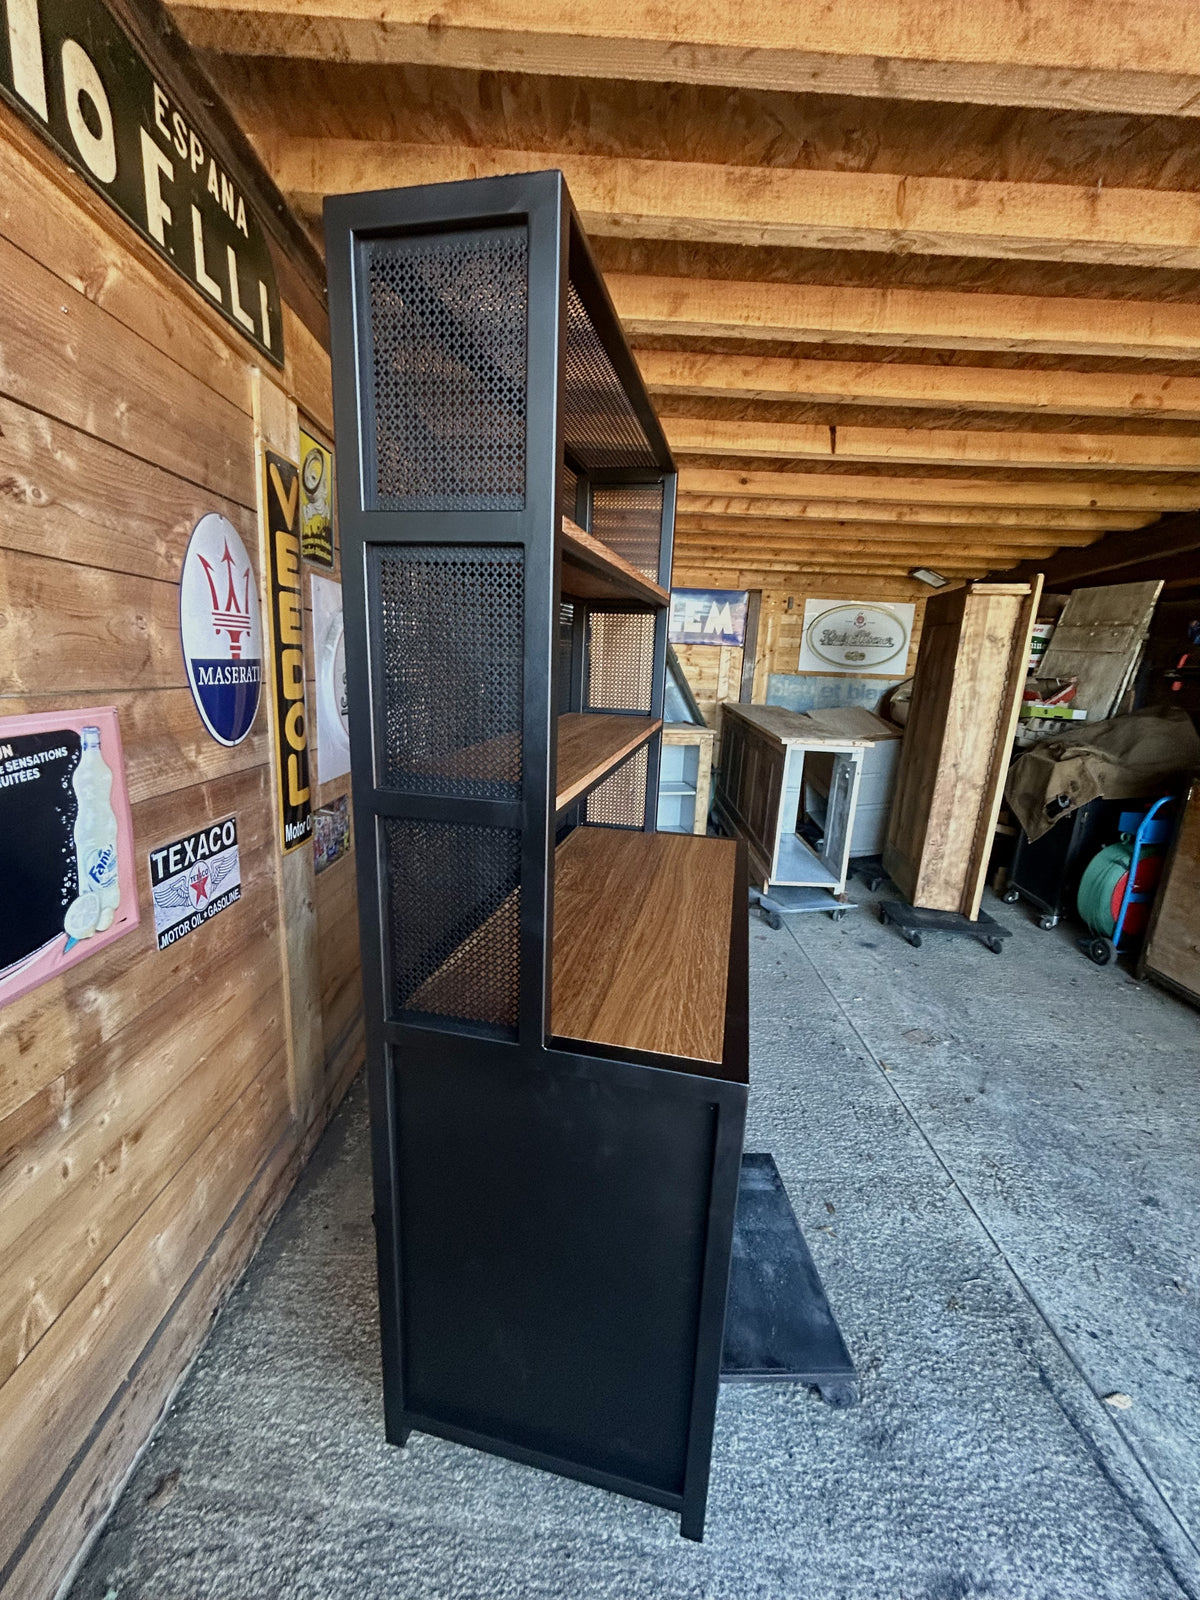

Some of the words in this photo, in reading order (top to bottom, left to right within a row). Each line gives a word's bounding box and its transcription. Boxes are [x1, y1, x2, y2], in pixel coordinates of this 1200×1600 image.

[268, 462, 310, 807] VEEDOL
[198, 666, 260, 685] MASERATI
[4, 746, 69, 773] SENSATIONS
[0, 767, 41, 788] UITÉES
[285, 821, 306, 843] Motor
[152, 820, 236, 880] TEXACO
[190, 868, 209, 883] TEXACO
[159, 920, 190, 949] MOTOR
[190, 911, 204, 929] OIL
[207, 888, 241, 918] GASOLINE
